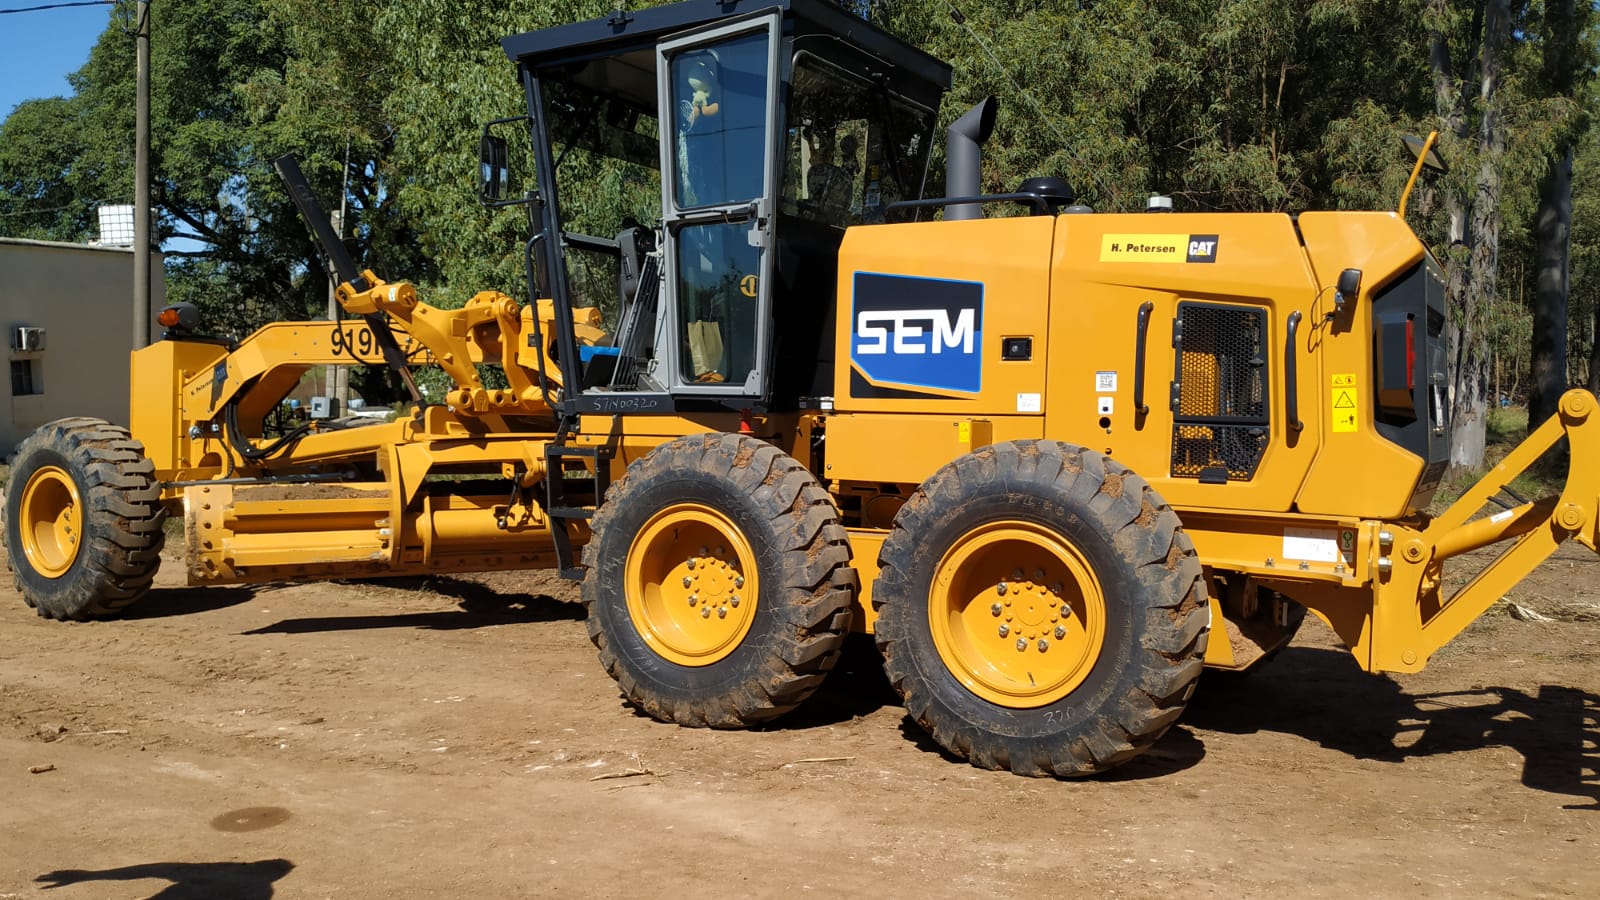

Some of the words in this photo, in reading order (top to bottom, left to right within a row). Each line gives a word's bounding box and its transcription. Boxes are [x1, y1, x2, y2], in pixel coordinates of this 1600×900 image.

[1111, 243, 1122, 253] H.
[1126, 243, 1176, 253] Petersen
[1189, 241, 1216, 256] CAT
[857, 308, 975, 354] SEM
